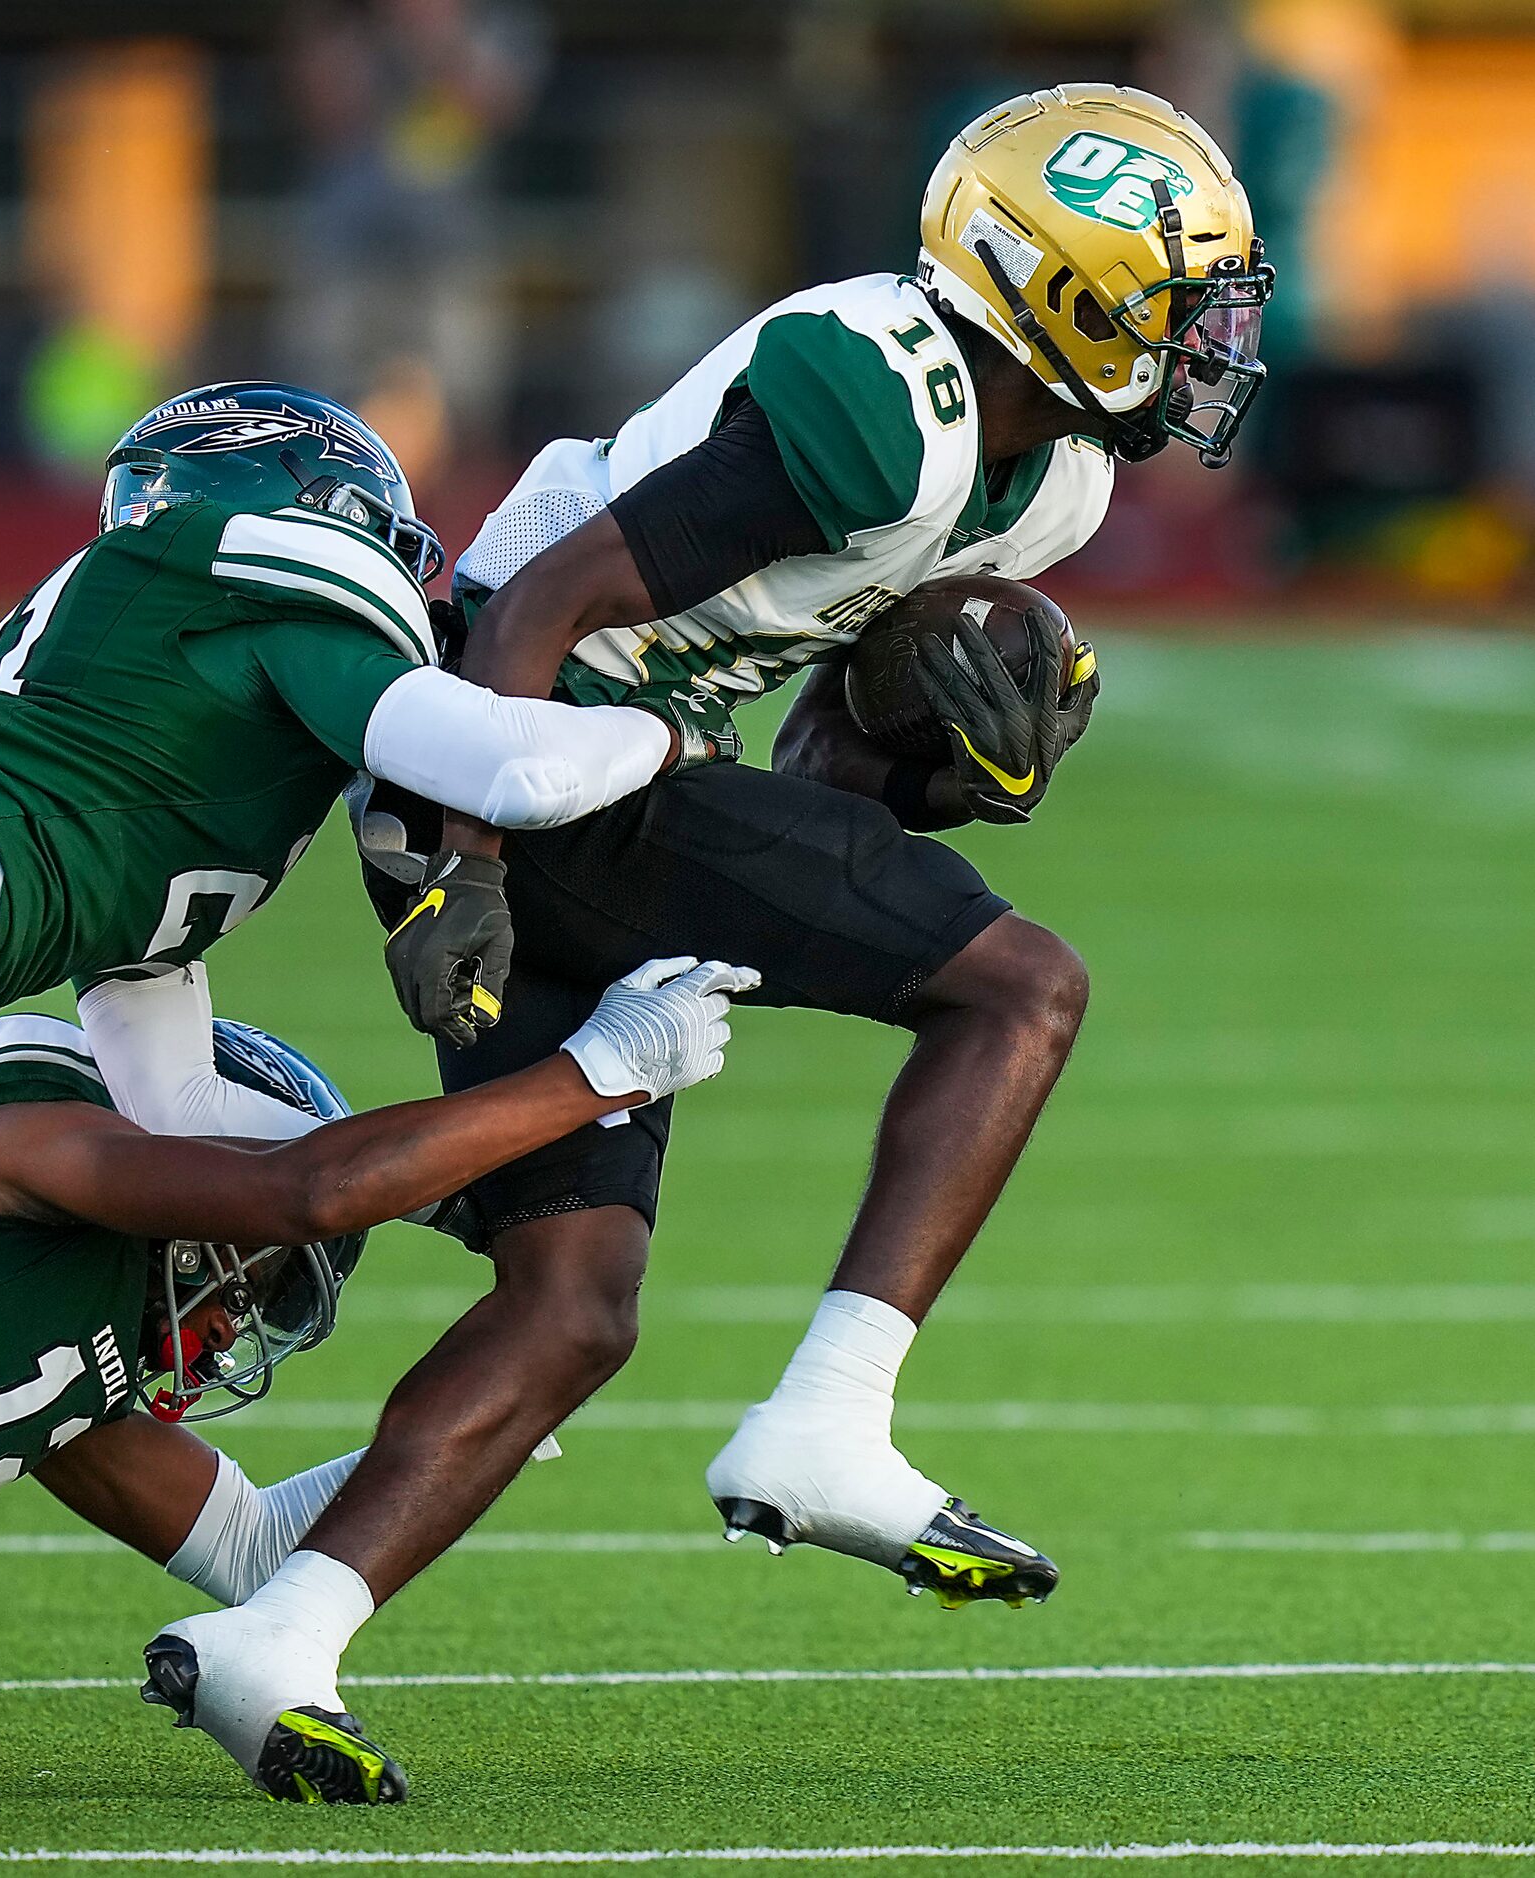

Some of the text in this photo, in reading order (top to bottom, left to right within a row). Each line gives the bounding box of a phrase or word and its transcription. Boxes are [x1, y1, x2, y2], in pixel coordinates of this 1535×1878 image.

[993, 223, 1022, 246] WARNING
[885, 312, 967, 432] 18
[154, 397, 240, 421] INDIANS
[91, 1324, 132, 1417] INDIA
